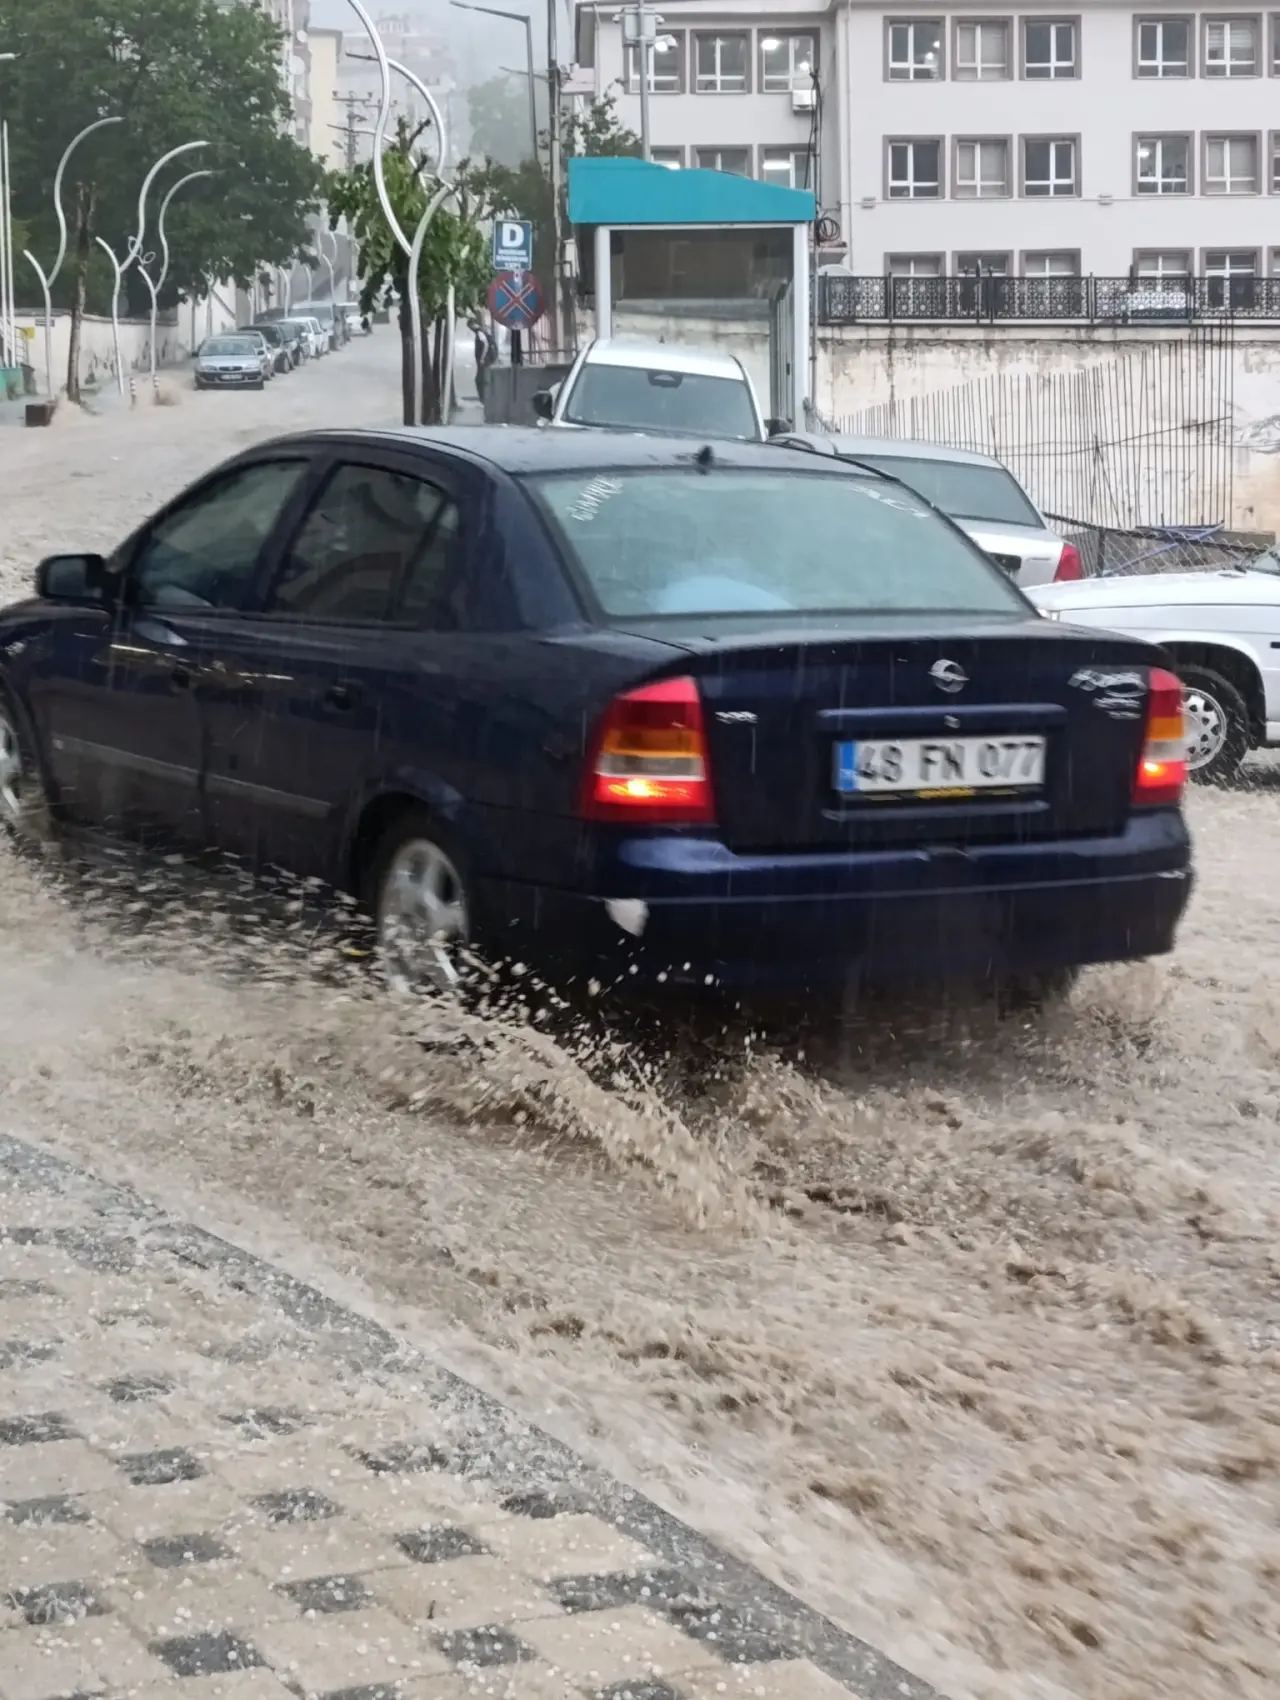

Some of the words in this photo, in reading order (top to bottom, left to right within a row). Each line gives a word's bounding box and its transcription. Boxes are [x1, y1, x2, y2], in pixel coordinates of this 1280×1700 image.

[502, 223, 525, 247] D
[920, 742, 966, 782] FN
[977, 741, 1042, 778] 077
